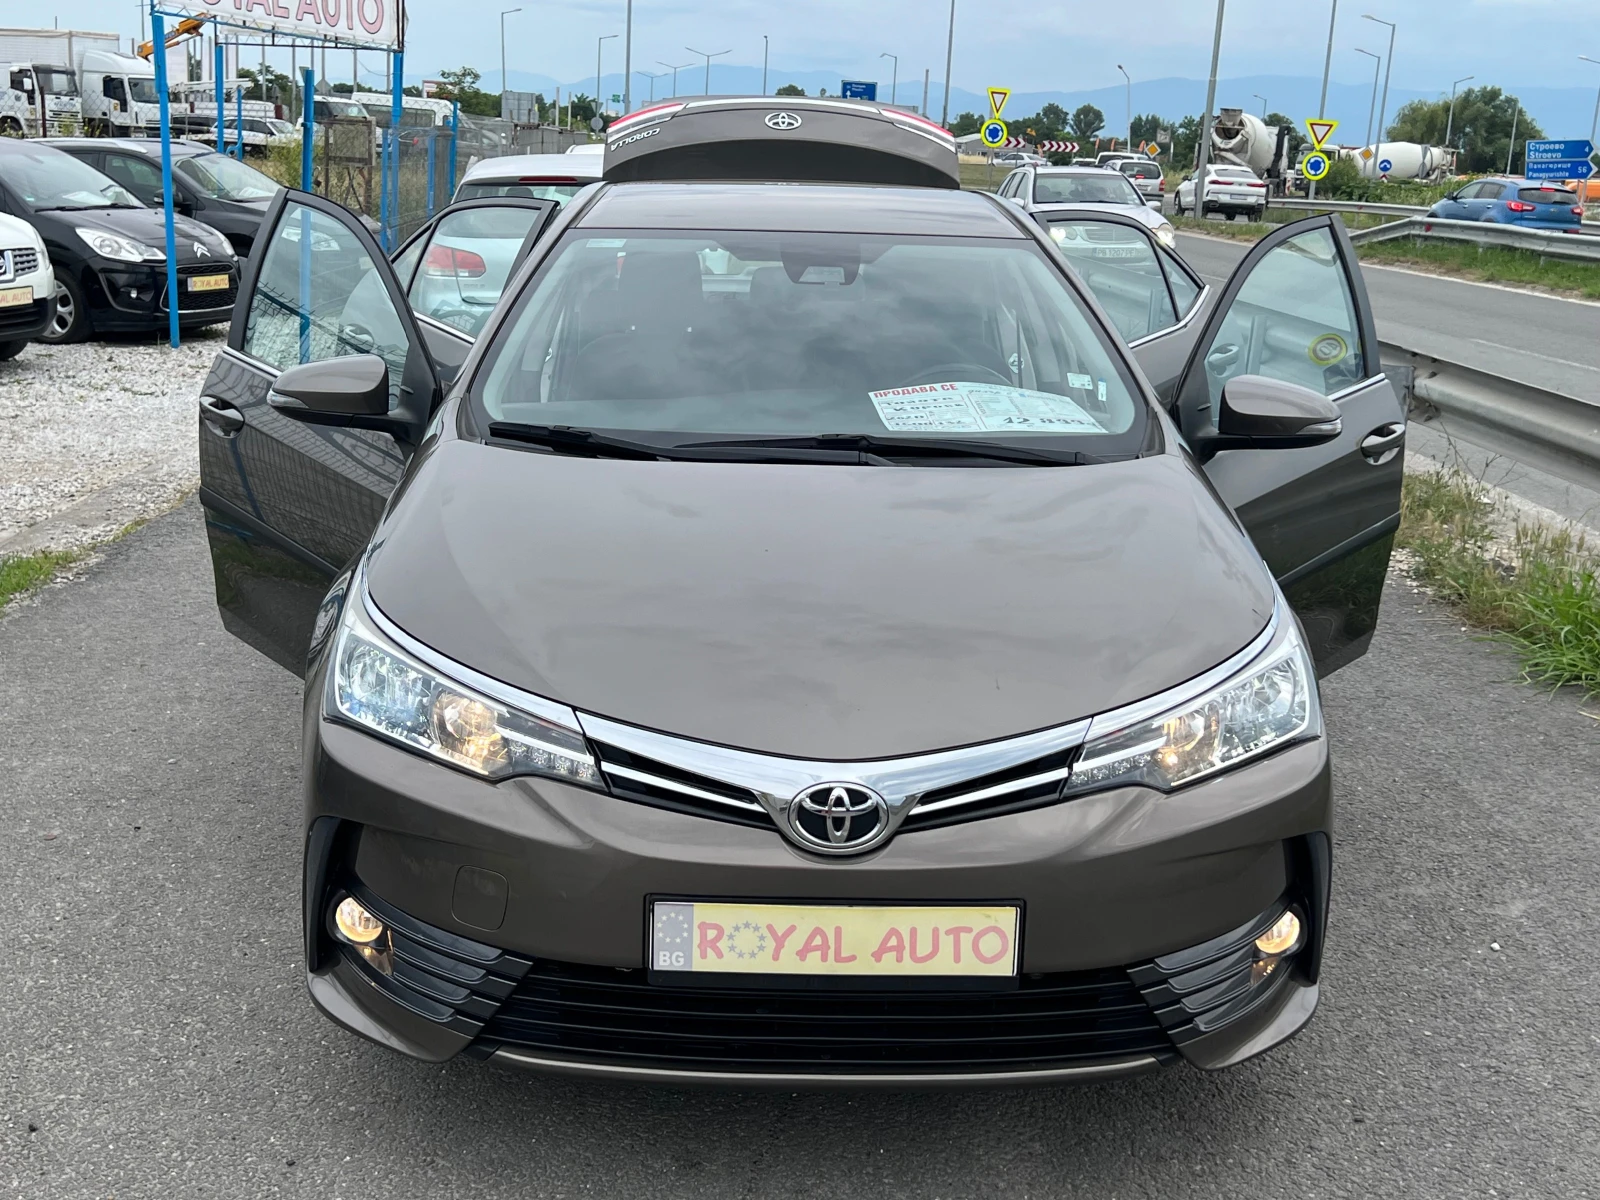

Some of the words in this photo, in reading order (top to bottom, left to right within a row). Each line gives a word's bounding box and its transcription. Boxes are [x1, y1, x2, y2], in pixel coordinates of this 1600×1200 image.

[611, 128, 660, 151] COROLLA
[1529, 142, 1565, 151] Строево
[1529, 151, 1562, 159] Stroevo
[1577, 165, 1588, 174] 56
[873, 385, 938, 398] ПРОДАВА
[940, 383, 959, 391] СЕ
[697, 920, 857, 965] ROYAL
[871, 925, 1010, 965] AUTO
[659, 951, 684, 967] BG
